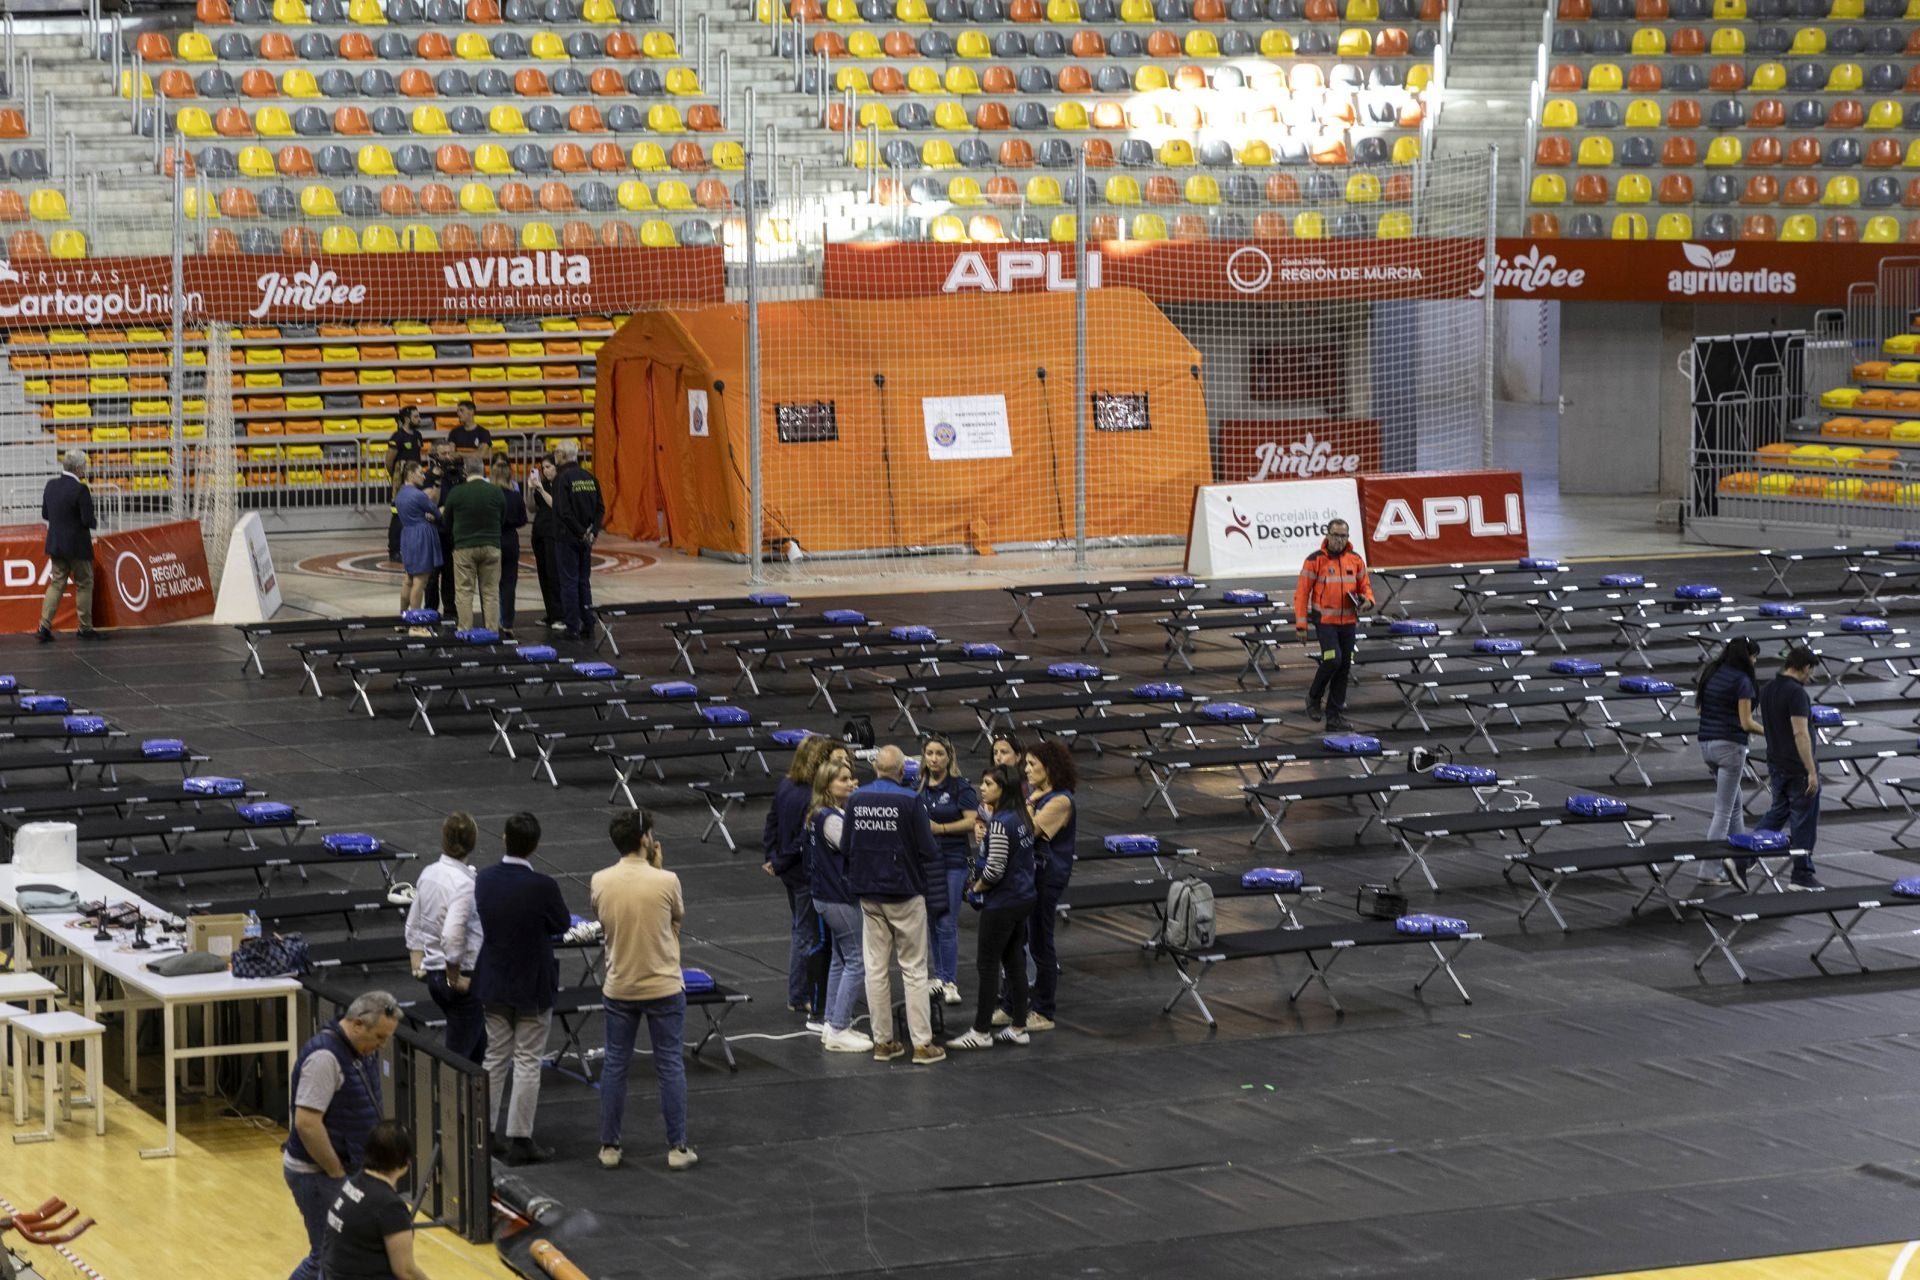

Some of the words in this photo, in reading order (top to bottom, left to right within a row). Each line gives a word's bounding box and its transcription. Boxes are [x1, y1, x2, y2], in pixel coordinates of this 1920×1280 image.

[22, 269, 120, 286] FRUTAS
[942, 251, 1102, 292] APLI
[1281, 266, 1338, 280] REGIÓN
[1341, 267, 1360, 280] DE
[1364, 266, 1423, 280] MURCIA
[1668, 267, 1796, 295] agriverdes
[249, 261, 367, 319] Jimbee
[443, 290, 521, 309] material
[527, 289, 592, 307] medico
[1247, 432, 1360, 481] Jimbee
[1322, 507, 1338, 520] de
[1373, 493, 1522, 541] APLI
[1257, 522, 1330, 541] Deporte
[151, 562, 187, 583] REGIÓN
[154, 583, 169, 599] DE
[168, 576, 205, 596] MURCIA
[853, 806, 899, 818] SERVICIOS
[854, 820, 898, 831] SOCIALES
